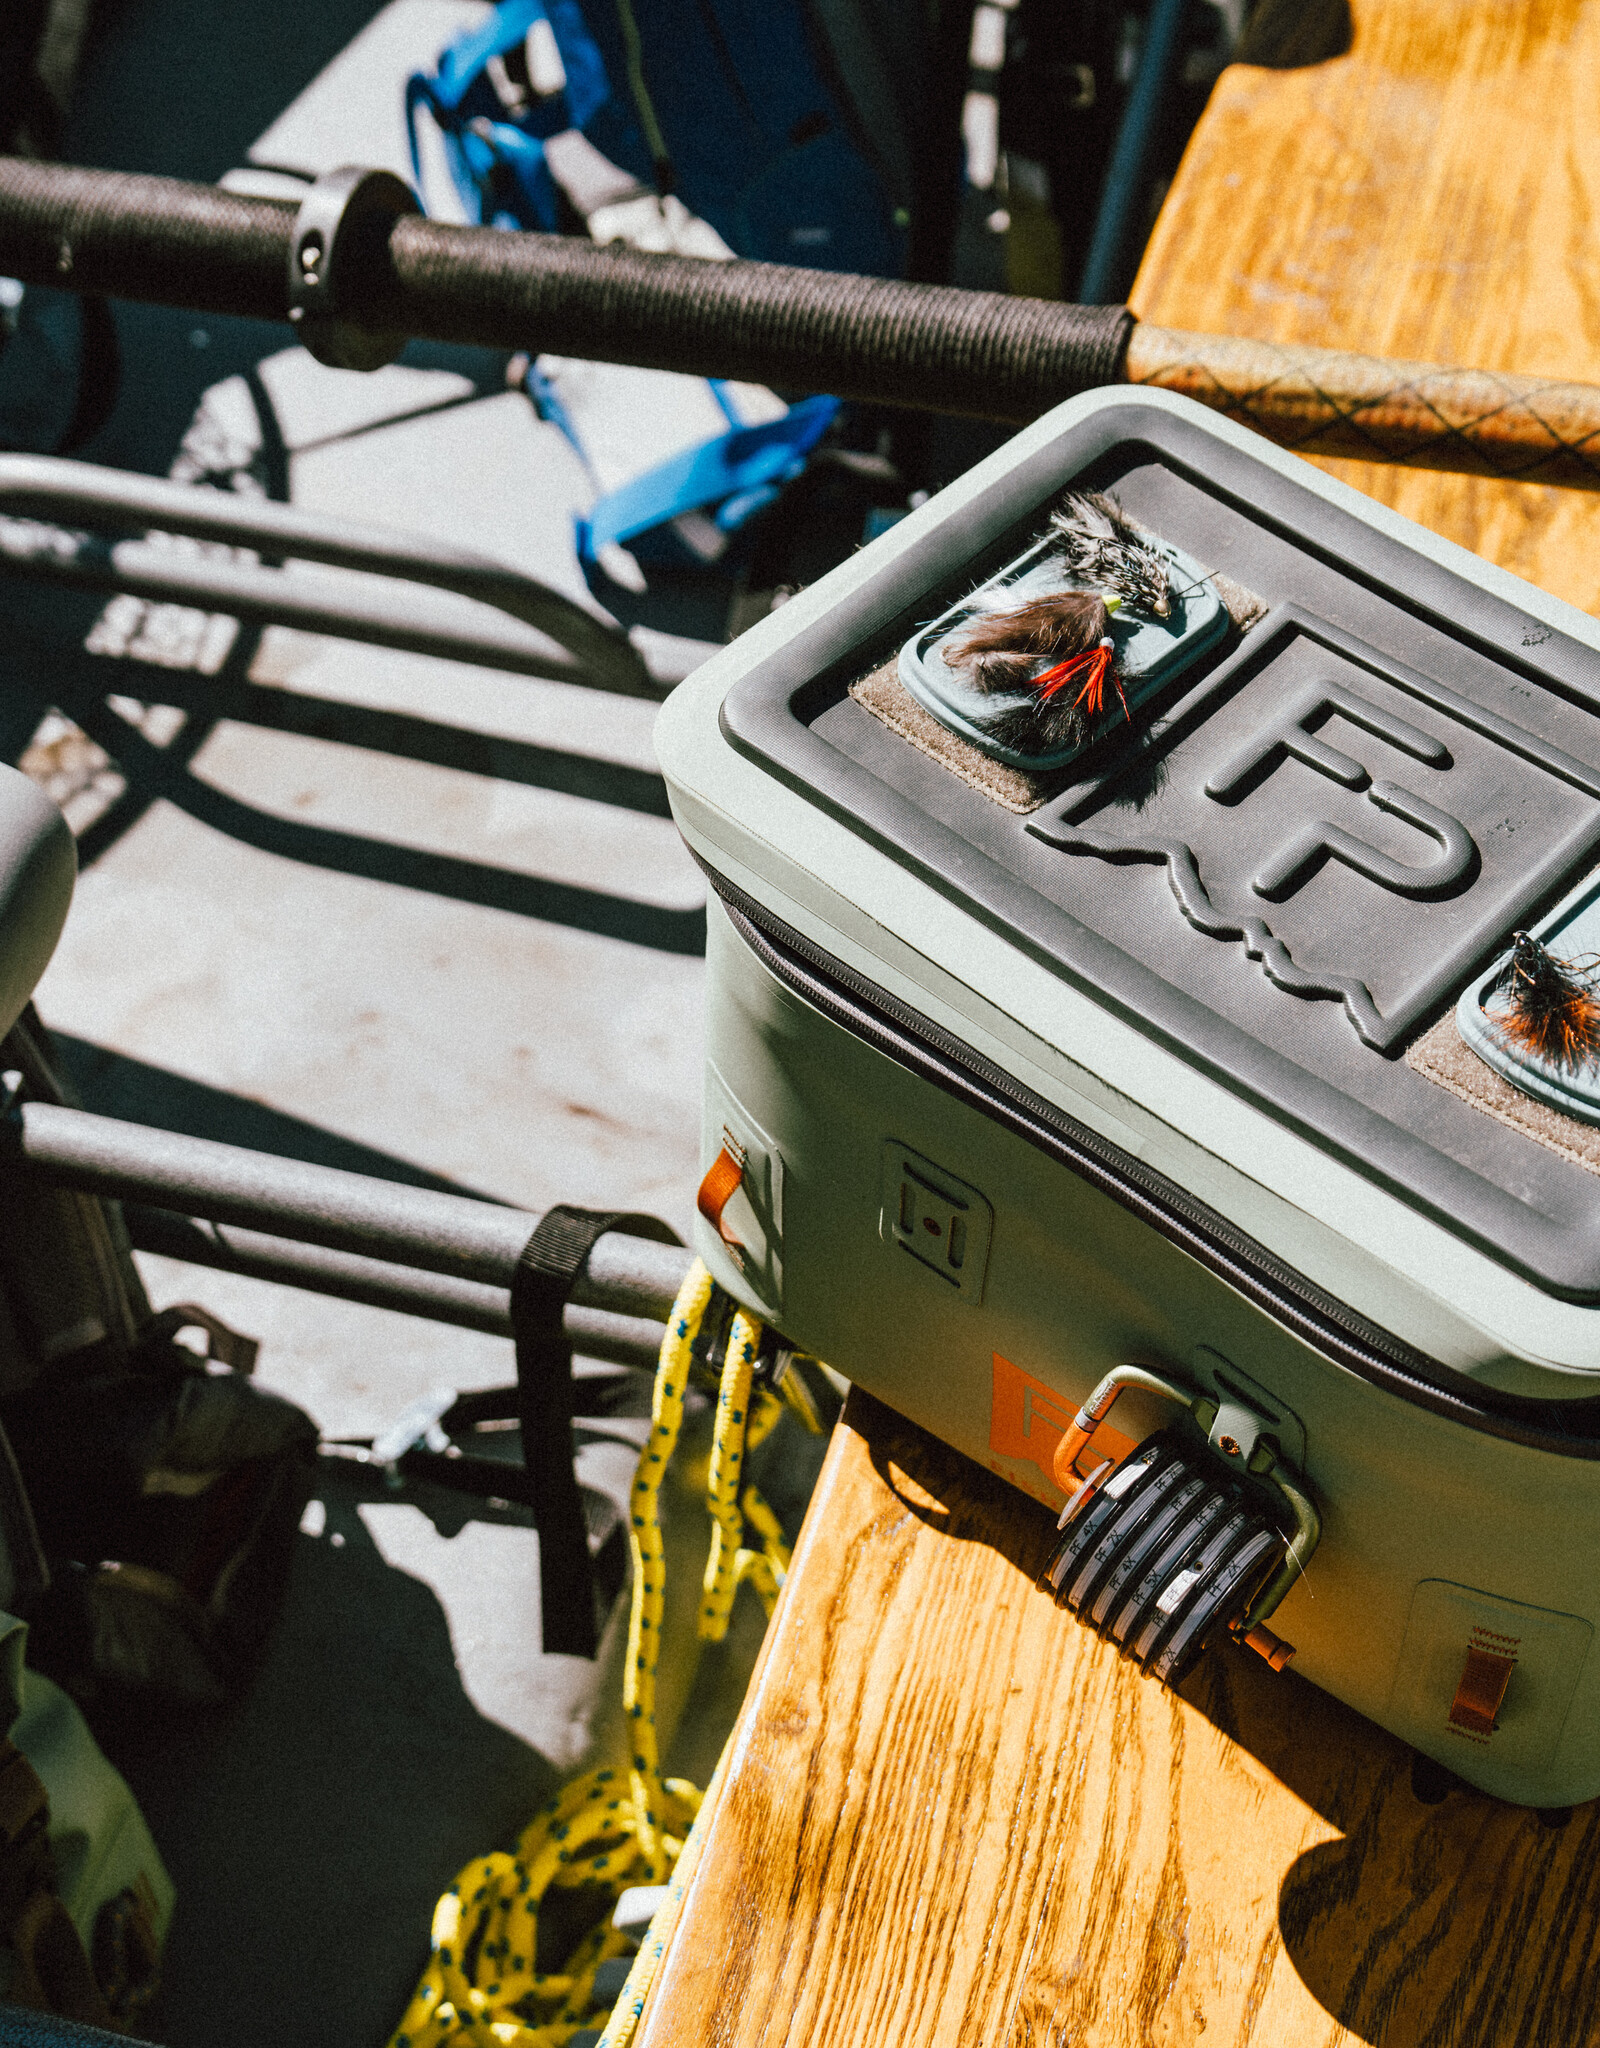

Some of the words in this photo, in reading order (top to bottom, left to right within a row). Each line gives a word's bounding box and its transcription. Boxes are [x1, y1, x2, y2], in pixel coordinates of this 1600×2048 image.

[1069, 1540, 1082, 1556] PF
[1083, 1521, 1098, 1536] 4X
[1094, 1547, 1108, 1564] PF
[1109, 1574, 1121, 1591] PF
[1122, 1556, 1137, 1572] 4X
[1131, 1588, 1146, 1606] PF
[1144, 1569, 1162, 1588] 5X
[1207, 1579, 1222, 1598] PF
[1222, 1561, 1241, 1579] 2X
[1152, 1611, 1167, 1629] PF
[1162, 1646, 1177, 1663] 2X
